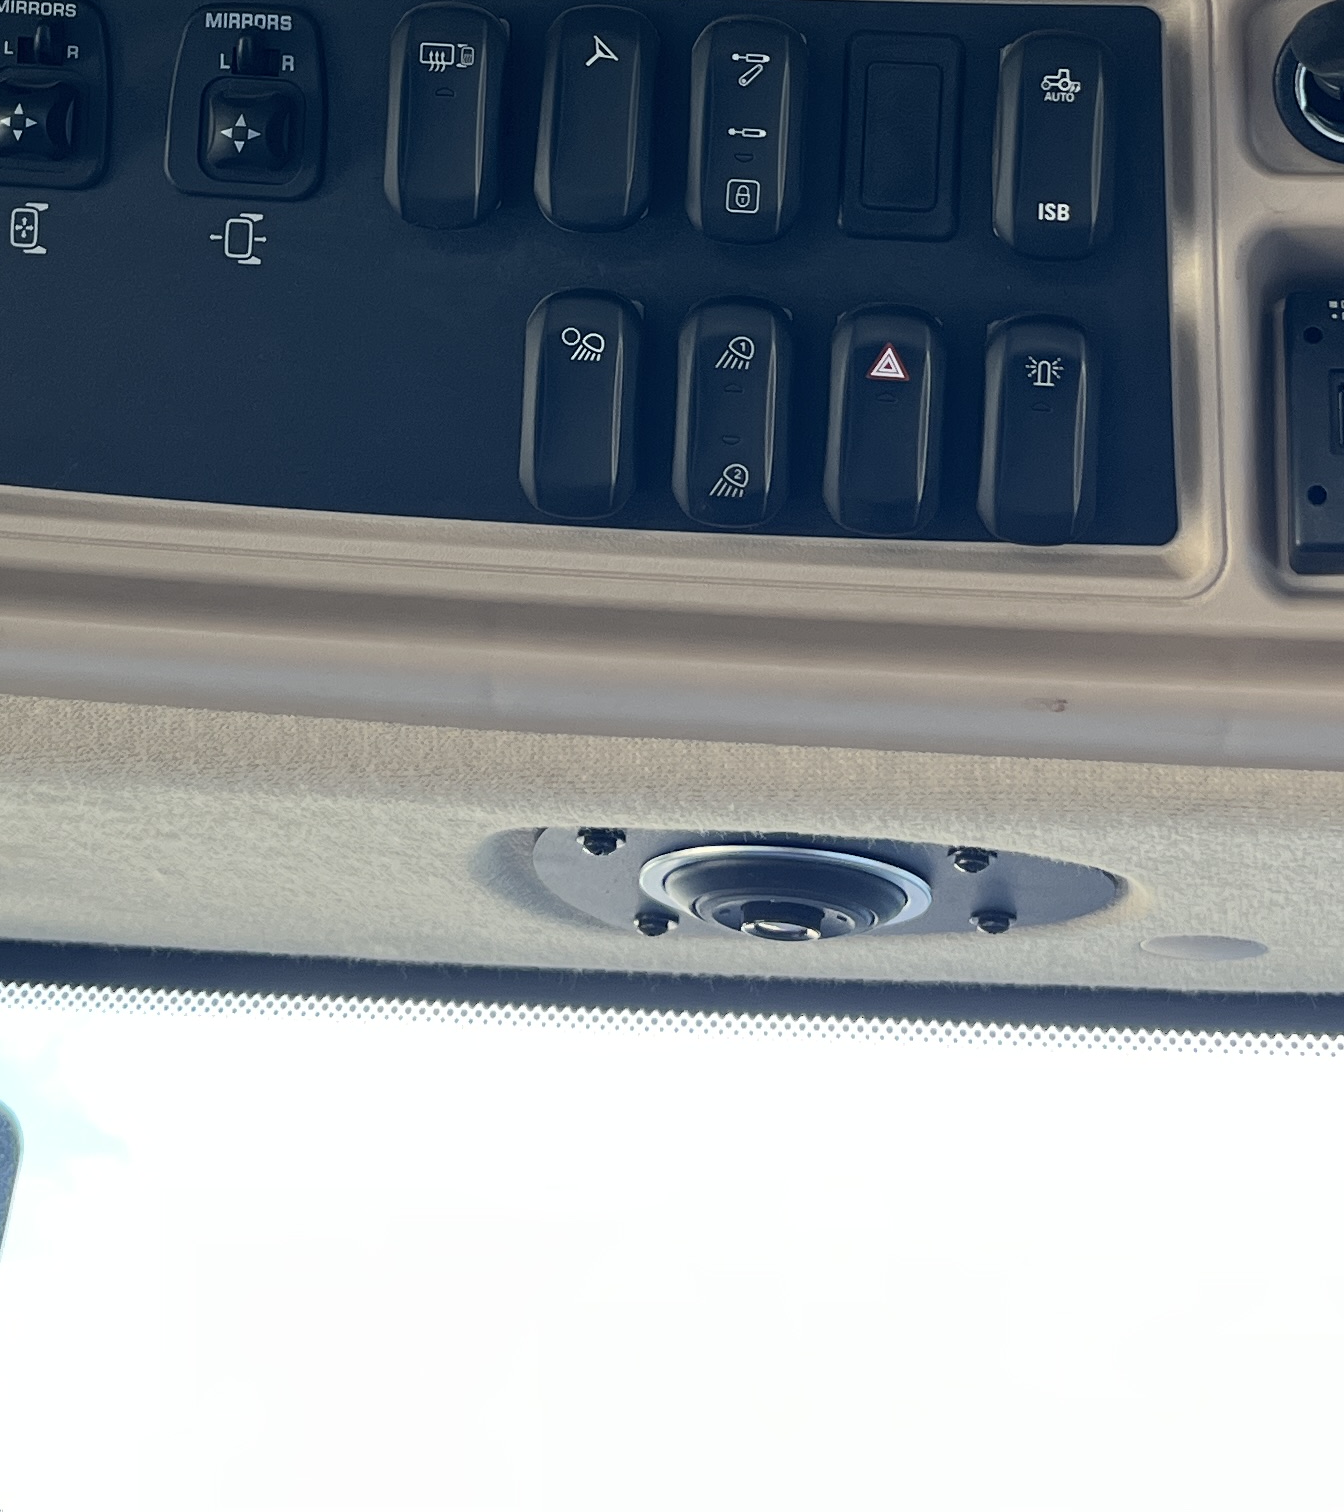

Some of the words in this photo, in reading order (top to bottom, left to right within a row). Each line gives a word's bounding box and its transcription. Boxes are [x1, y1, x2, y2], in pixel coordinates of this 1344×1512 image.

[205, 12, 293, 31] MIRRORS
[4, 41, 13, 55] L
[67, 45, 79, 59] R
[220, 53, 230, 69] L
[282, 55, 294, 71] R
[1044, 91, 1075, 103] AUTO
[1038, 203, 1070, 221] ISB
